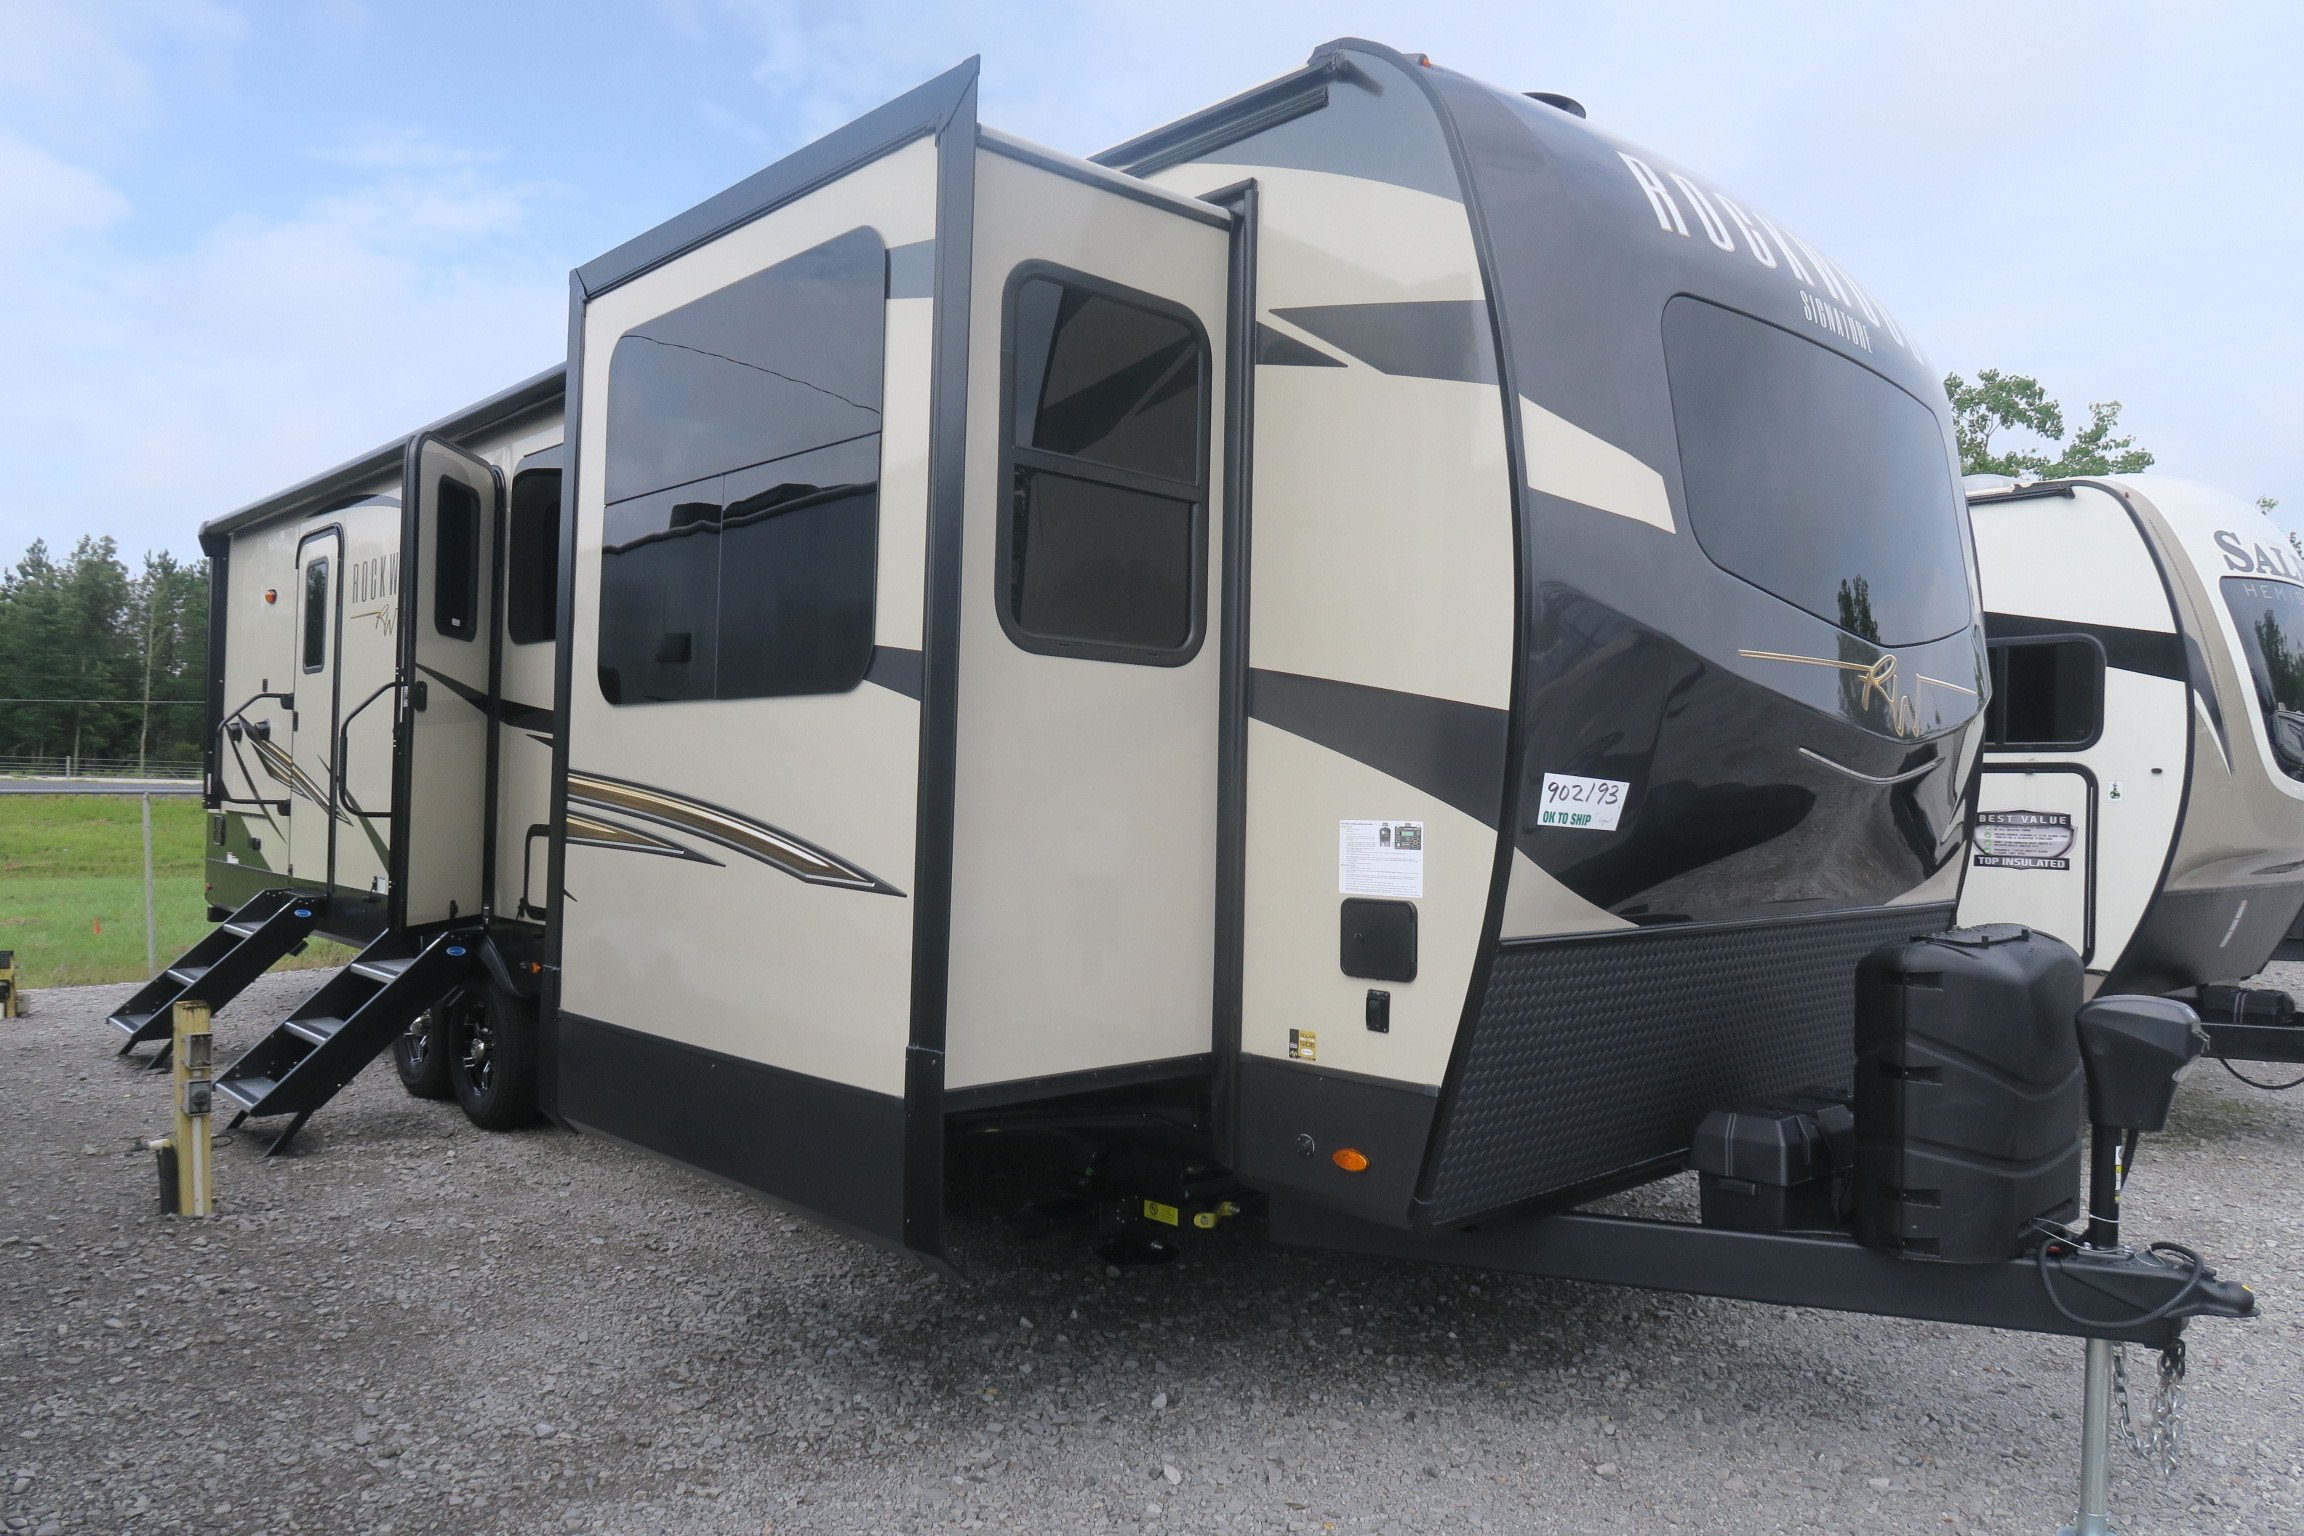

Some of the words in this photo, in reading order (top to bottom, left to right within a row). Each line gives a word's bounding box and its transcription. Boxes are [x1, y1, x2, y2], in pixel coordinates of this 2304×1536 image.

[1799, 290, 1873, 354] SIGNATURE
[352, 552, 399, 604] ROCKW
[1542, 811, 1556, 823] OK
[1558, 812, 1569, 825] TO
[1570, 813, 1592, 826] SHIP
[1979, 814, 2015, 823] BEST
[2021, 815, 2067, 825] VALUE
[1978, 856, 2000, 865] TOP
[2002, 857, 2066, 868] INSULATED
[1300, 1041, 1316, 1049] SIDE
